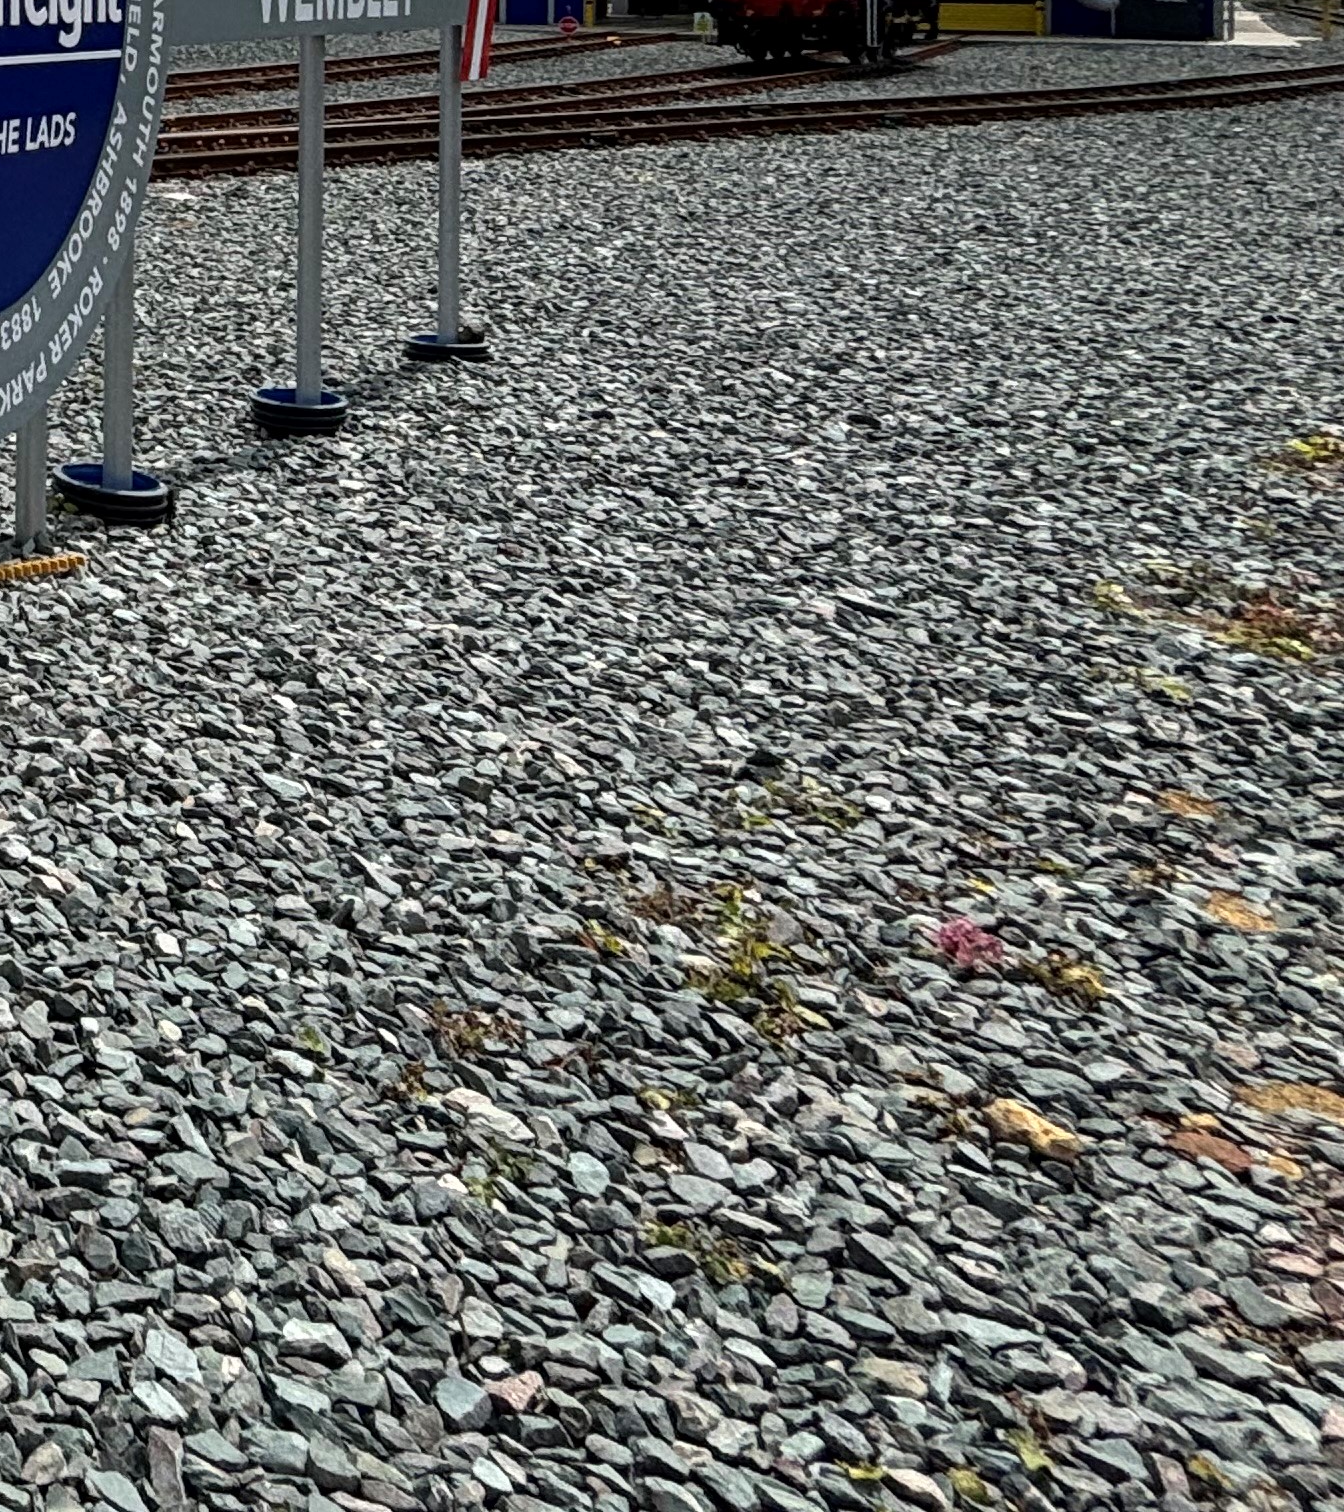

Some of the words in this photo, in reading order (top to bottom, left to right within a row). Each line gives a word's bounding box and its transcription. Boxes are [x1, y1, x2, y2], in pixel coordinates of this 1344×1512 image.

[25, 111, 77, 152] LADS
[47, 101, 128, 300] ASHBROOKE
[108, 176, 138, 252] 1898
[0, 296, 42, 351] 1883
[48, 266, 104, 364] ROKER
